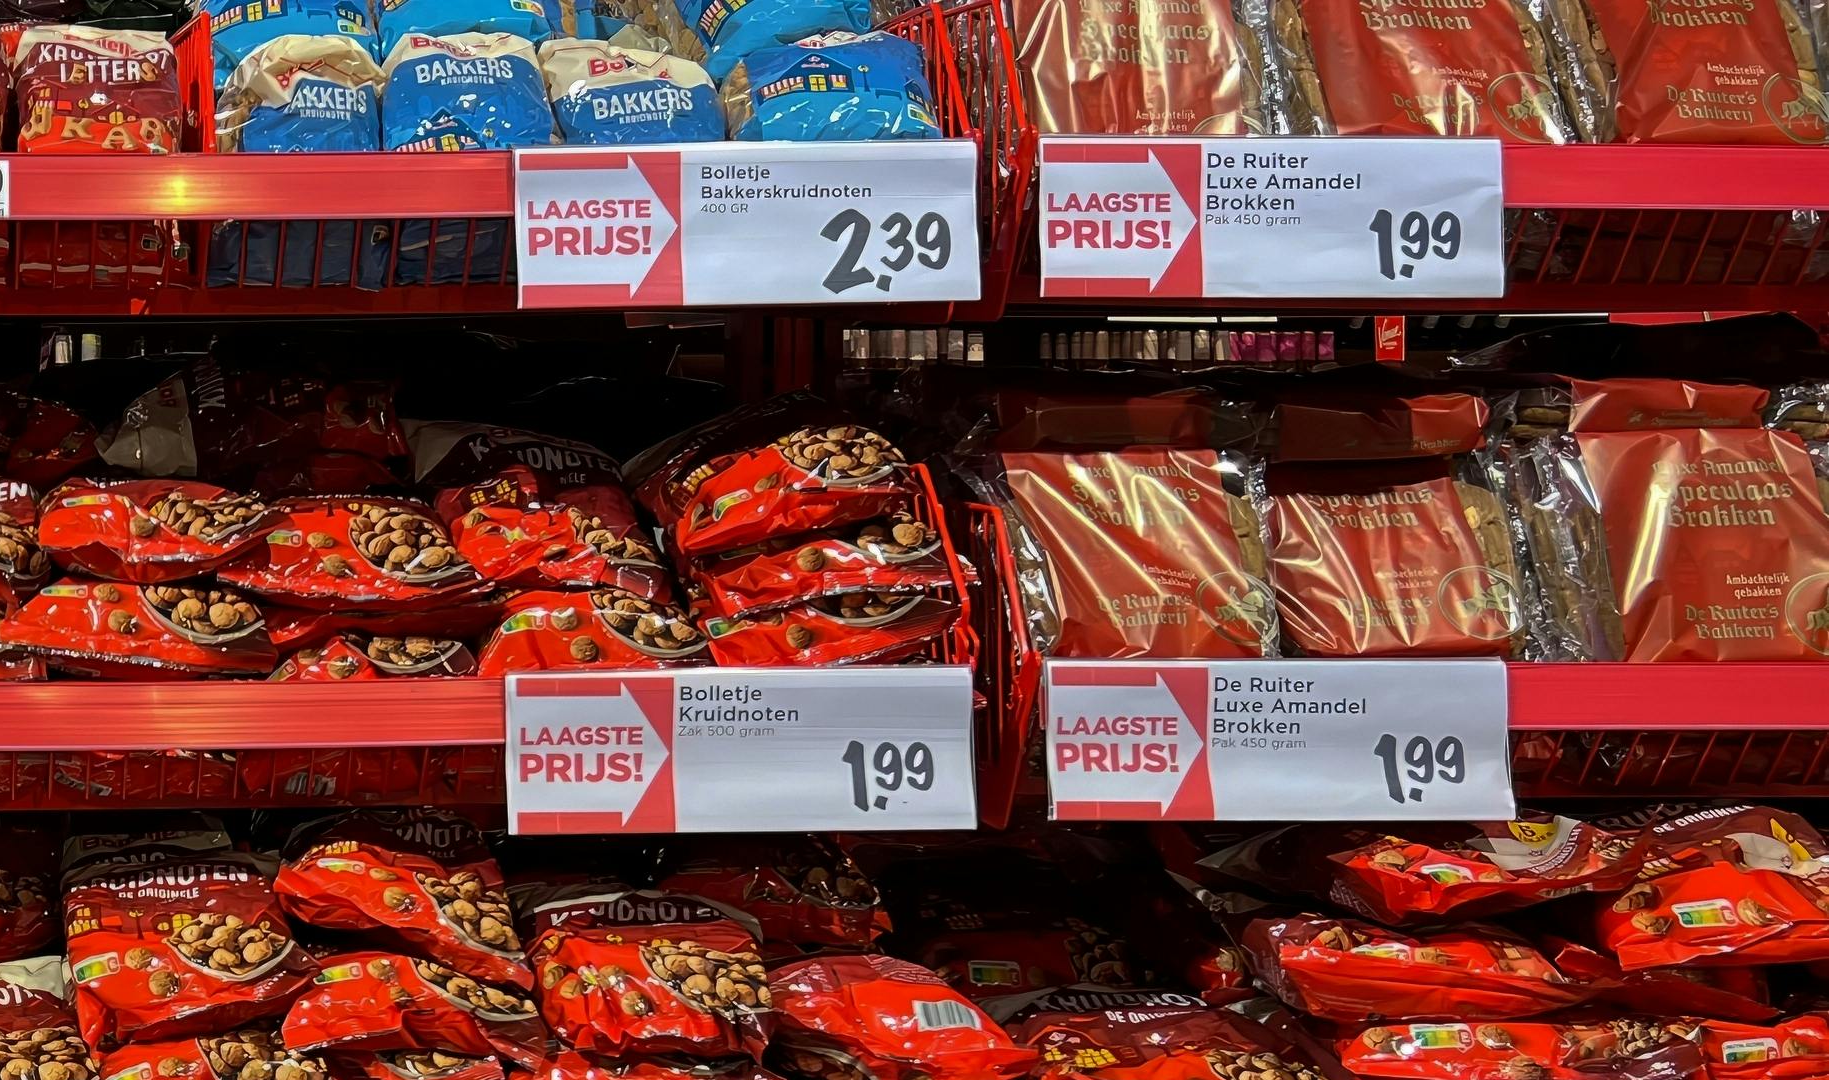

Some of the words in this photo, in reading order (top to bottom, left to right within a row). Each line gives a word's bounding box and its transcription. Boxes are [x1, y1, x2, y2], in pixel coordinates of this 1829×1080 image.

[414, 59, 514, 85] BAKKERS
[284, 85, 367, 113] AKKERS
[592, 88, 693, 120] BAKKERS
[1207, 153, 1238, 169] De
[1243, 153, 1309, 169] Ruiter
[701, 165, 771, 182] Bolletje
[1207, 174, 1261, 190] Luxe
[1265, 173, 1362, 190] Amandel
[701, 183, 872, 200] Bakkerskruidnoten
[527, 199, 651, 221] LAAGSTE
[701, 203, 728, 213] 400
[731, 203, 749, 213] GR
[1047, 191, 1171, 214] LAAGSTE
[1207, 194, 1296, 211] Brokken
[1206, 214, 1230, 225] Pak
[1234, 214, 1262, 225] 450
[1266, 216, 1301, 228] gram
[528, 227, 652, 256] PRIJS!
[1047, 220, 1172, 250] PRIJS!
[1726, 572, 1790, 587] Ambachtelijk
[1734, 586, 1782, 599] gebakken
[1214, 676, 1245, 693] De
[1250, 676, 1315, 693] Ruiter
[679, 685, 763, 704] Bolletje
[679, 705, 800, 723] Kruidnoten
[1213, 698, 1266, 715] Luxe
[1271, 697, 1368, 715] Amandel
[678, 725, 703, 736] Zak
[707, 725, 735, 736] 500
[740, 727, 775, 739] gram
[1057, 716, 1179, 737] LAAGSTE
[1213, 718, 1302, 735] Brokken
[519, 726, 644, 746] LAAGSTE
[1212, 738, 1236, 748] Pak
[1240, 737, 1268, 748] 450
[1271, 740, 1307, 751] gram
[1056, 743, 1180, 774] PRIJS!
[519, 752, 644, 784] PRIJS!
